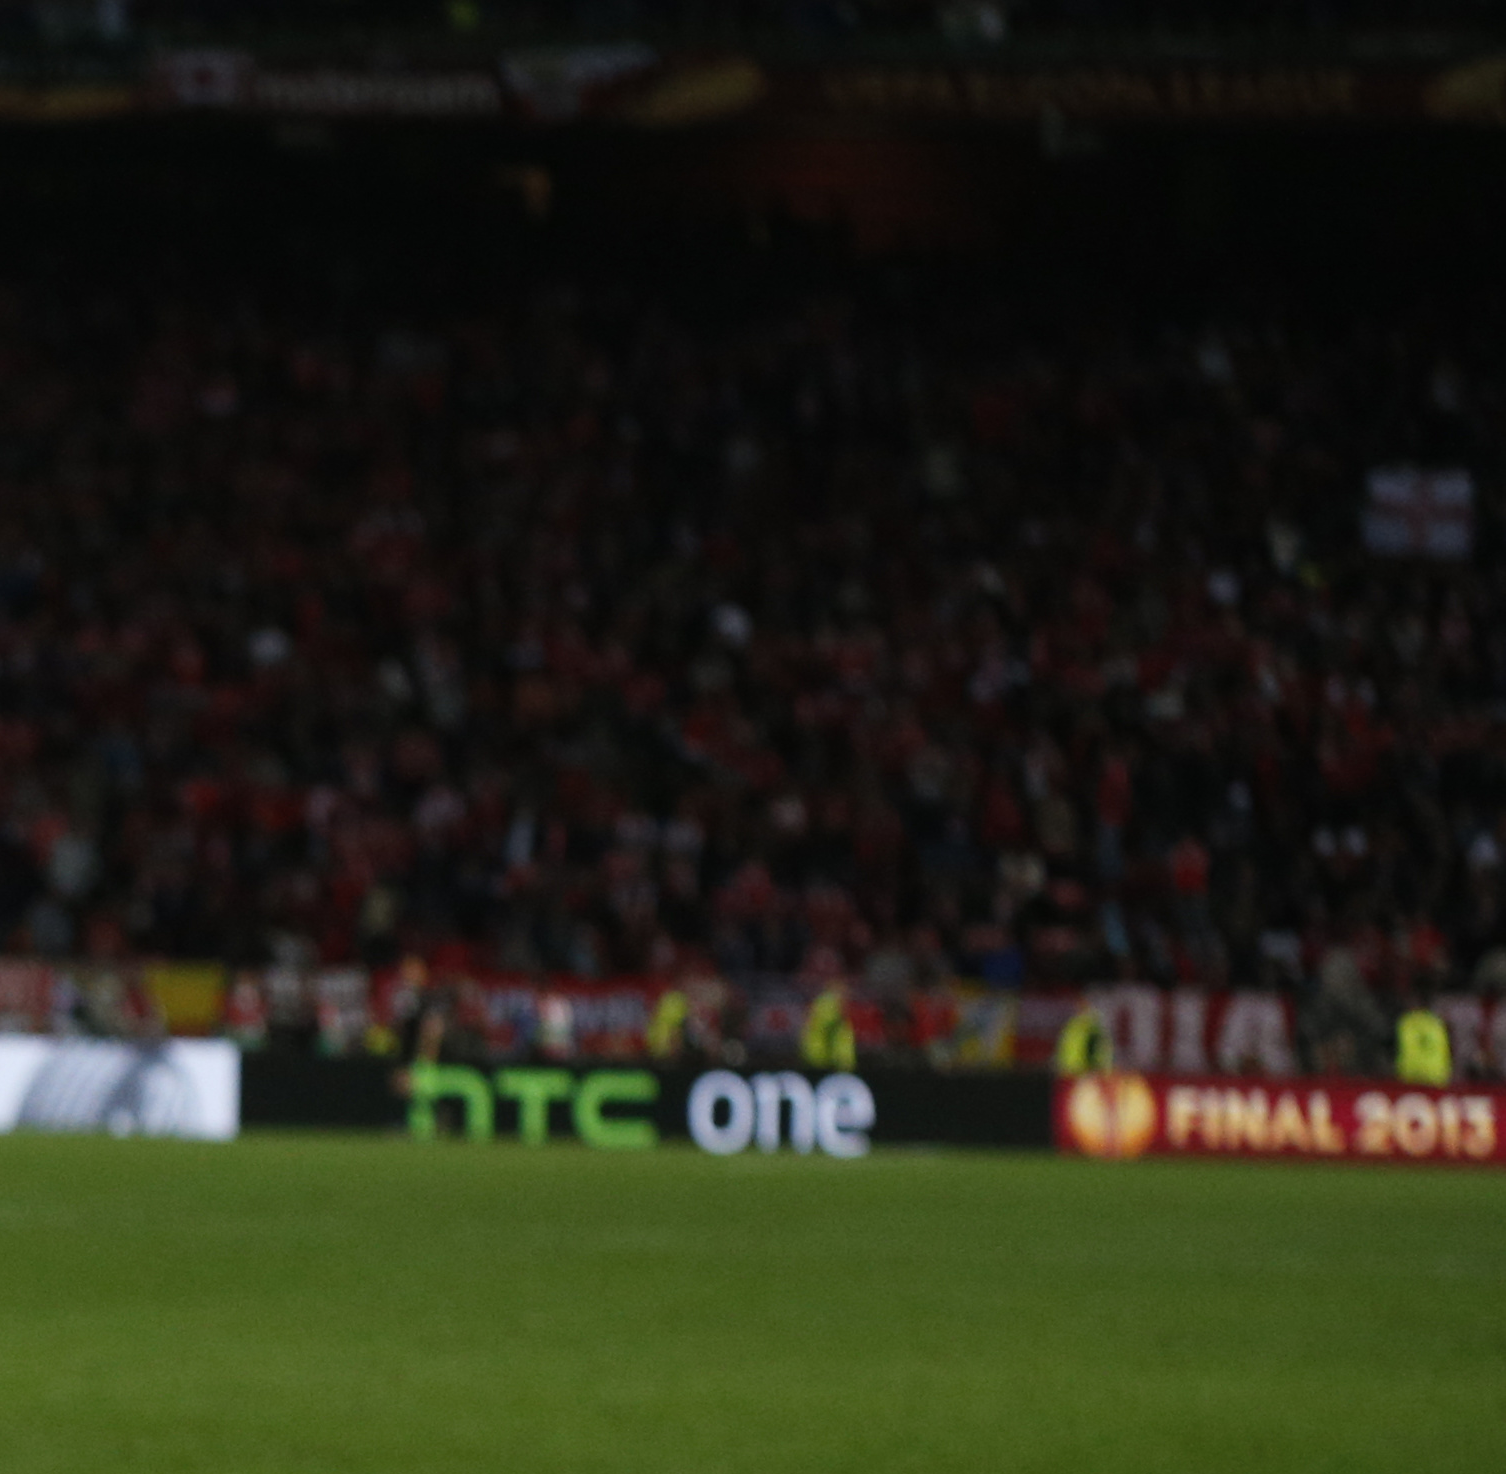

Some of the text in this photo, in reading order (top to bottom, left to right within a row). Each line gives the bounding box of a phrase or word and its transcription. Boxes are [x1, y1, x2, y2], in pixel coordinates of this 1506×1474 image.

[687, 1069, 877, 1158] one
[1165, 1085, 1497, 1159] FINAL 2013
